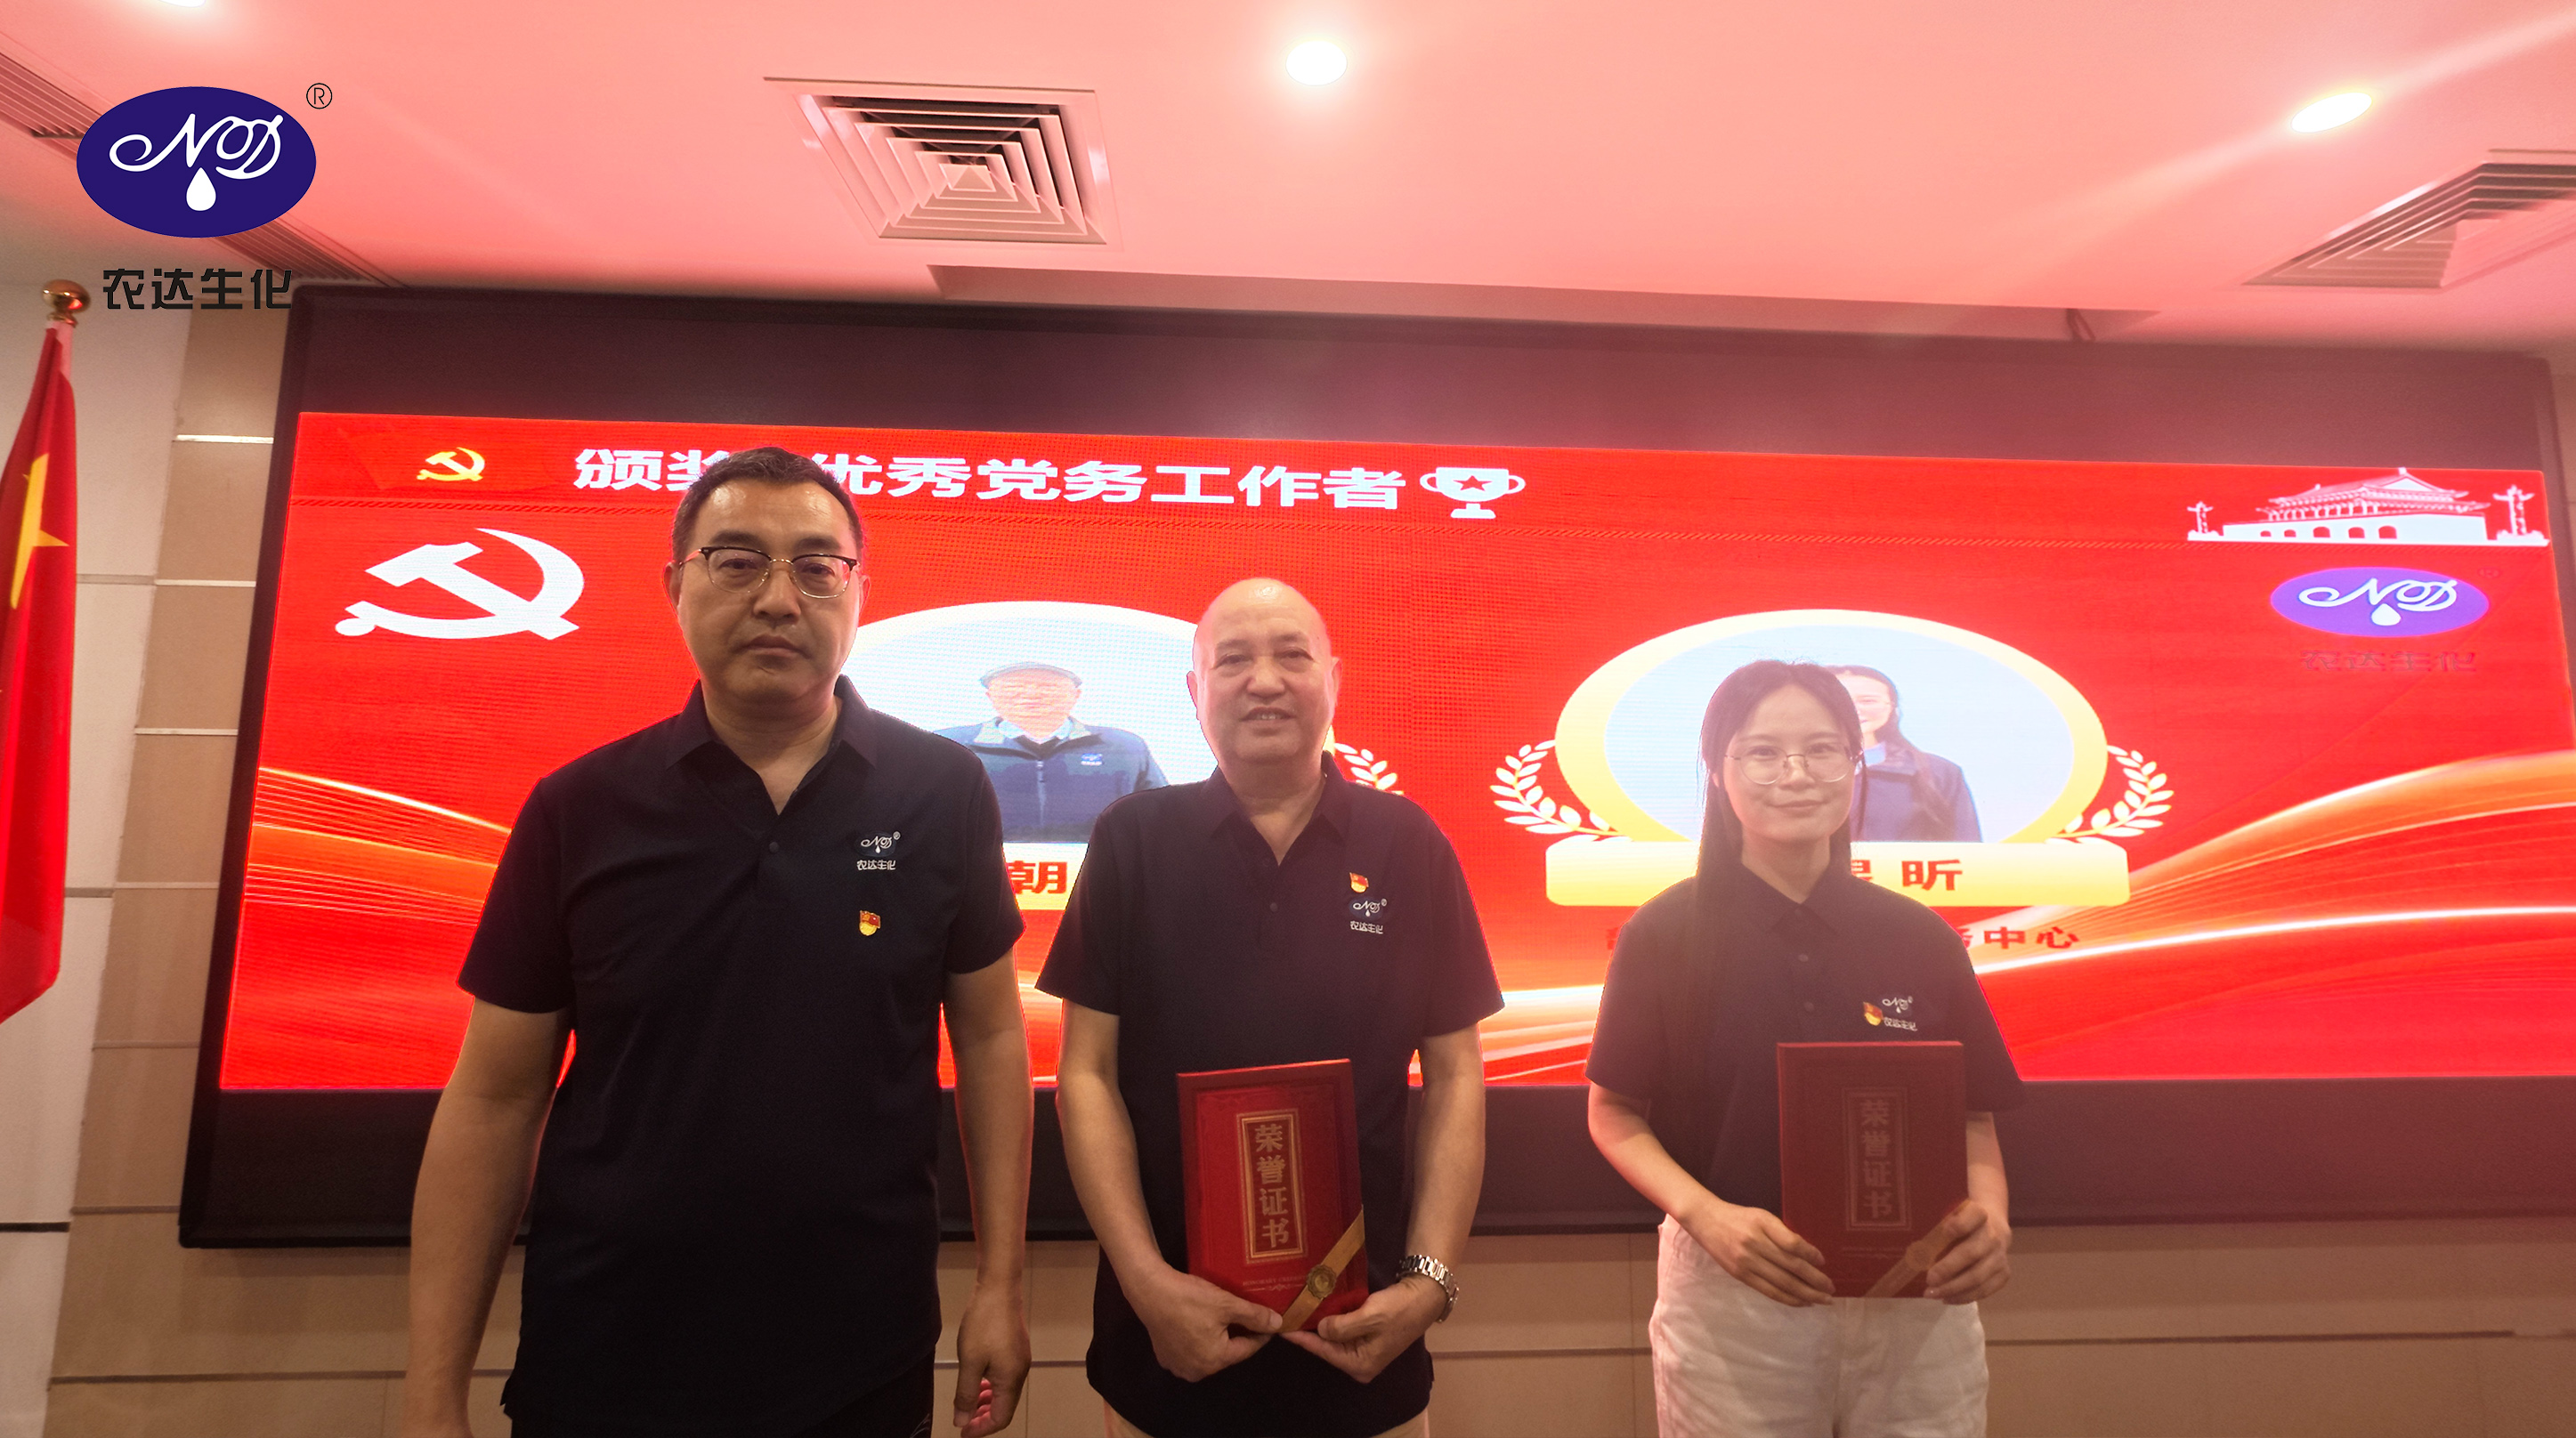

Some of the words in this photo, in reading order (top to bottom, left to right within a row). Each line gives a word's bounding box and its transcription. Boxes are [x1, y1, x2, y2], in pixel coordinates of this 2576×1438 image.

[811, 452, 1406, 510] 优秀党务工作者
[856, 859, 896, 871] 农达生化
[1254, 1123, 1290, 1248] 荣誉证书
[1860, 1099, 1893, 1219] 荣誉证书
